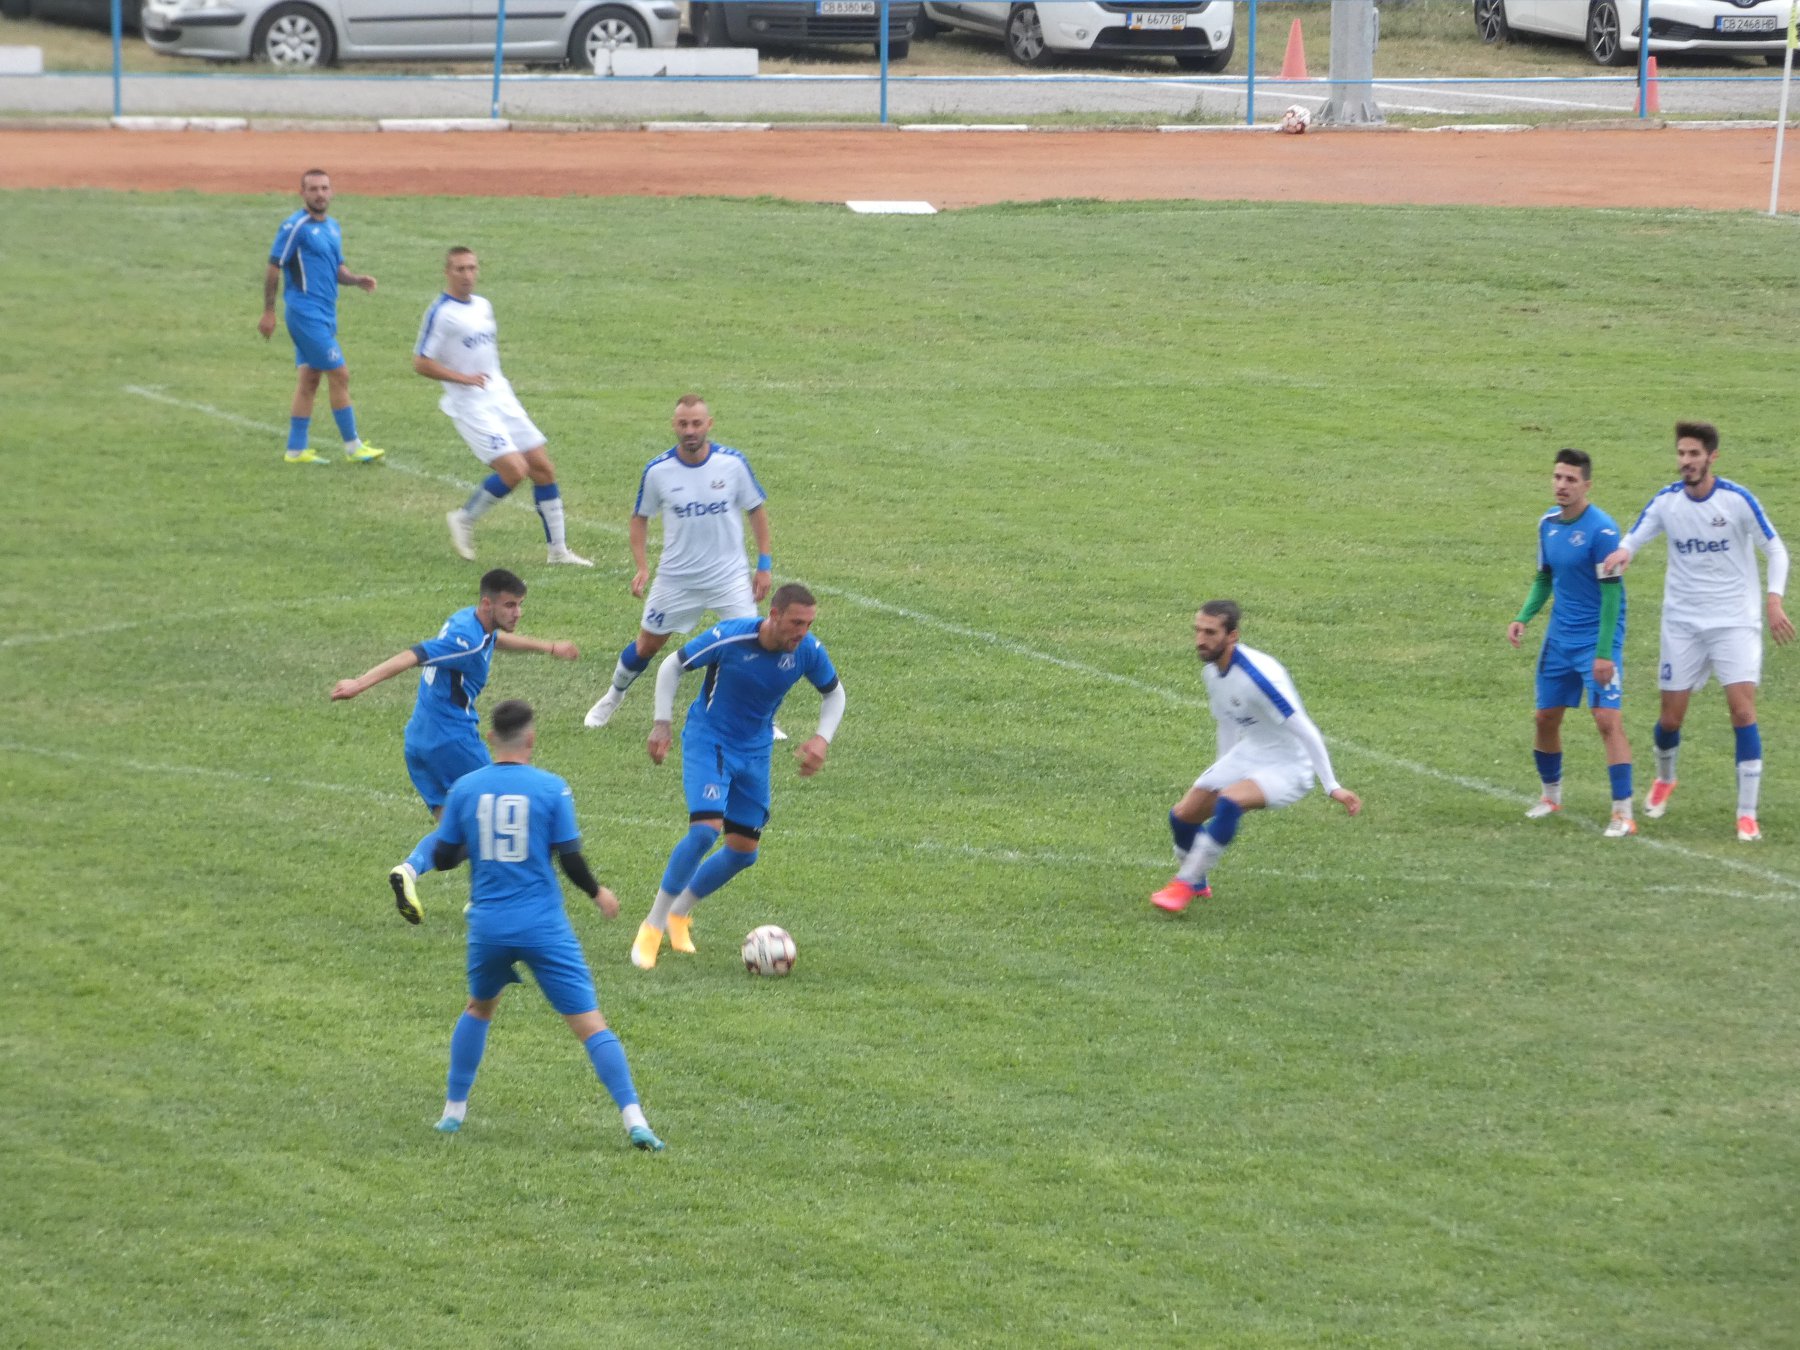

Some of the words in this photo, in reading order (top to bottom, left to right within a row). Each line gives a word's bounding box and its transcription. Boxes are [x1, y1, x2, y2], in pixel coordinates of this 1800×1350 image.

[674, 499, 729, 519] efbet
[1676, 538, 1730, 555] efbet
[646, 608, 665, 628] 24
[477, 793, 530, 862] 19
